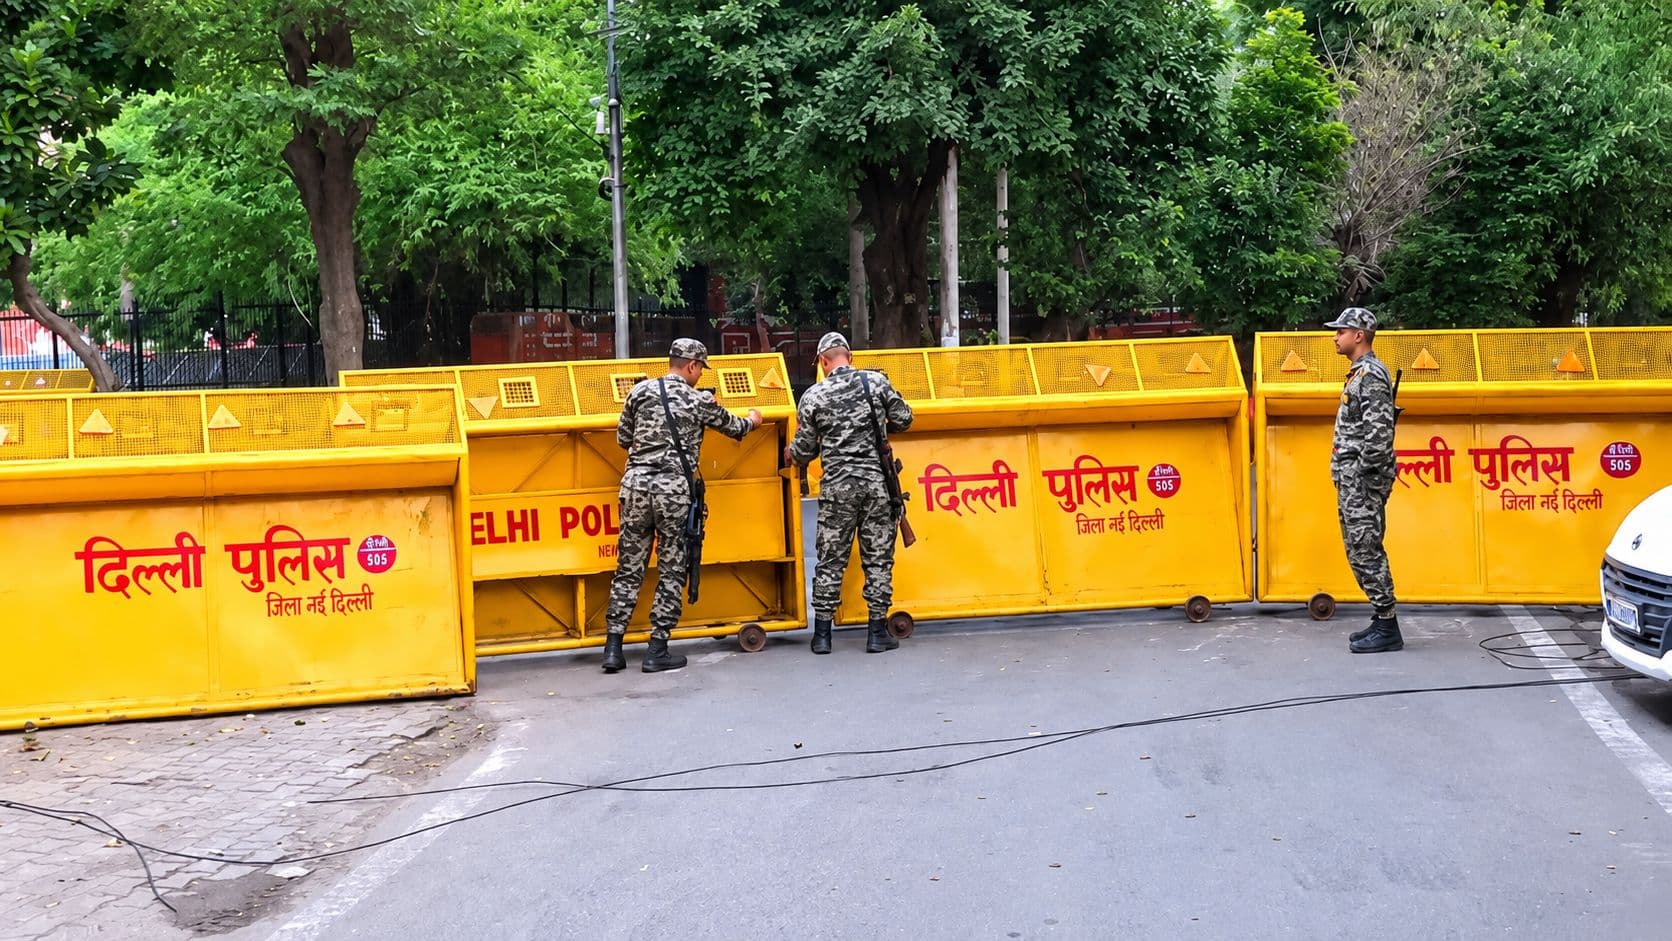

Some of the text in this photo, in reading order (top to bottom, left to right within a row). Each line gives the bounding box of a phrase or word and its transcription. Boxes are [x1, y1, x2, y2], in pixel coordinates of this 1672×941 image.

[1396, 434, 1574, 490] ल्ली पुलिस
[918, 454, 1139, 517] दिल्ली पुलिस
[1500, 488, 1603, 513] जिला नई दिल्ली
[471, 504, 621, 545] ELHI POL
[1076, 507, 1165, 535] जिला नई दिल्ली
[75, 524, 351, 599] दिल्ली पुलिस
[265, 583, 374, 617] जिला नई दिल्ली
